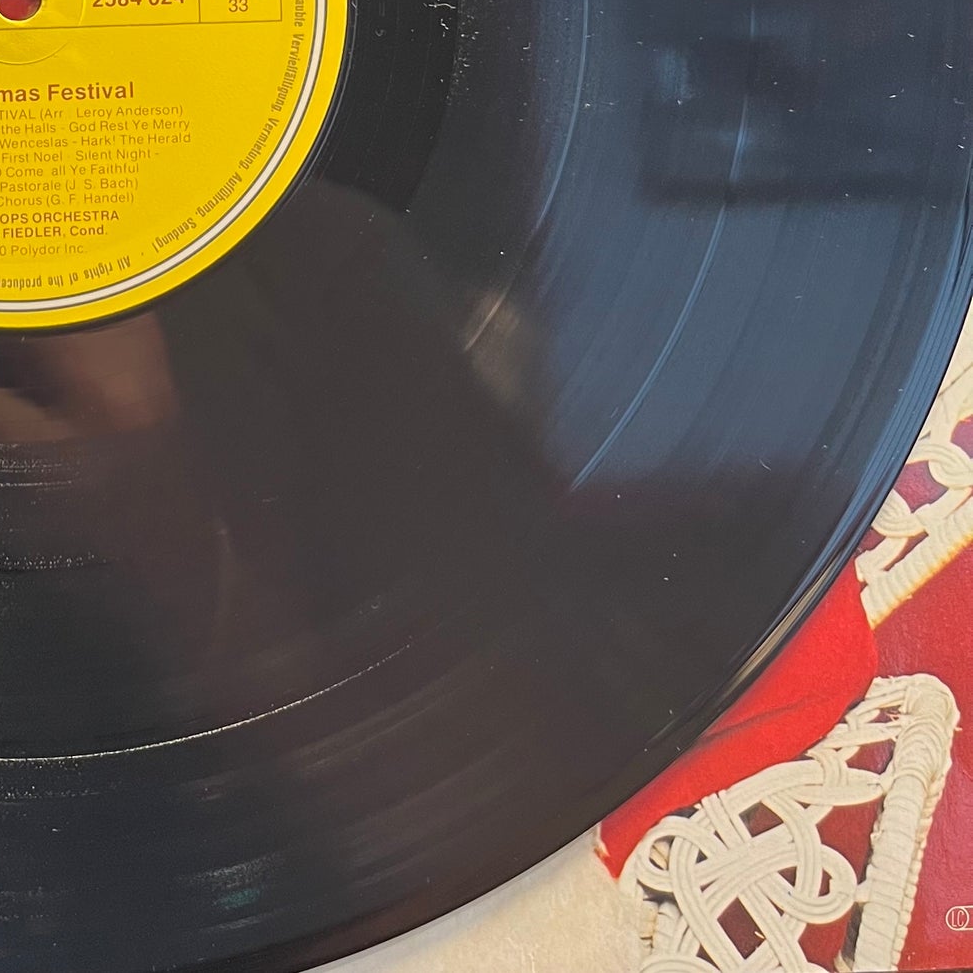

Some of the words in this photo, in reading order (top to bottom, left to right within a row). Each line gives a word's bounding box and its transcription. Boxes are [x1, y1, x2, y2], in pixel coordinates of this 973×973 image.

[47, 82, 134, 101] Festival
[77, 108, 112, 120] Leroy
[116, 105, 183, 117] Anderson)
[1, 125, 21, 135] the
[25, 123, 56, 134] Halls
[69, 122, 96, 133] God
[100, 121, 128, 131] Rest
[132, 120, 149, 130] Ye
[153, 119, 190, 132] Merry
[0, 137, 68, 149] Wenceslas
[81, 136, 115, 146] Hark!
[121, 135, 143, 145] The
[148, 133, 190, 144] Herald
[2, 153, 28, 163] First
[34, 151, 63, 162] Noel
[76, 150, 112, 161] Silent
[116, 149, 150, 162] Night
[51, 166, 65, 176] all
[70, 165, 86, 175] Ye
[91, 163, 139, 174] Faithful
[0, 180, 61, 192] Pastorale
[100, 177, 138, 189] Bach)
[84, 192, 135, 204] Handel)
[32, 211, 119, 223] ORCHESTRA
[70, 225, 108, 236] Cond.
[152, 218, 196, 253] Sendung!
[10, 244, 59, 257] Polydor
[84, 262, 113, 279] rights
[117, 256, 130, 271] All
[48, 275, 63, 287] the
[69, 273, 78, 285] of
[951, 909, 964, 927] LC
